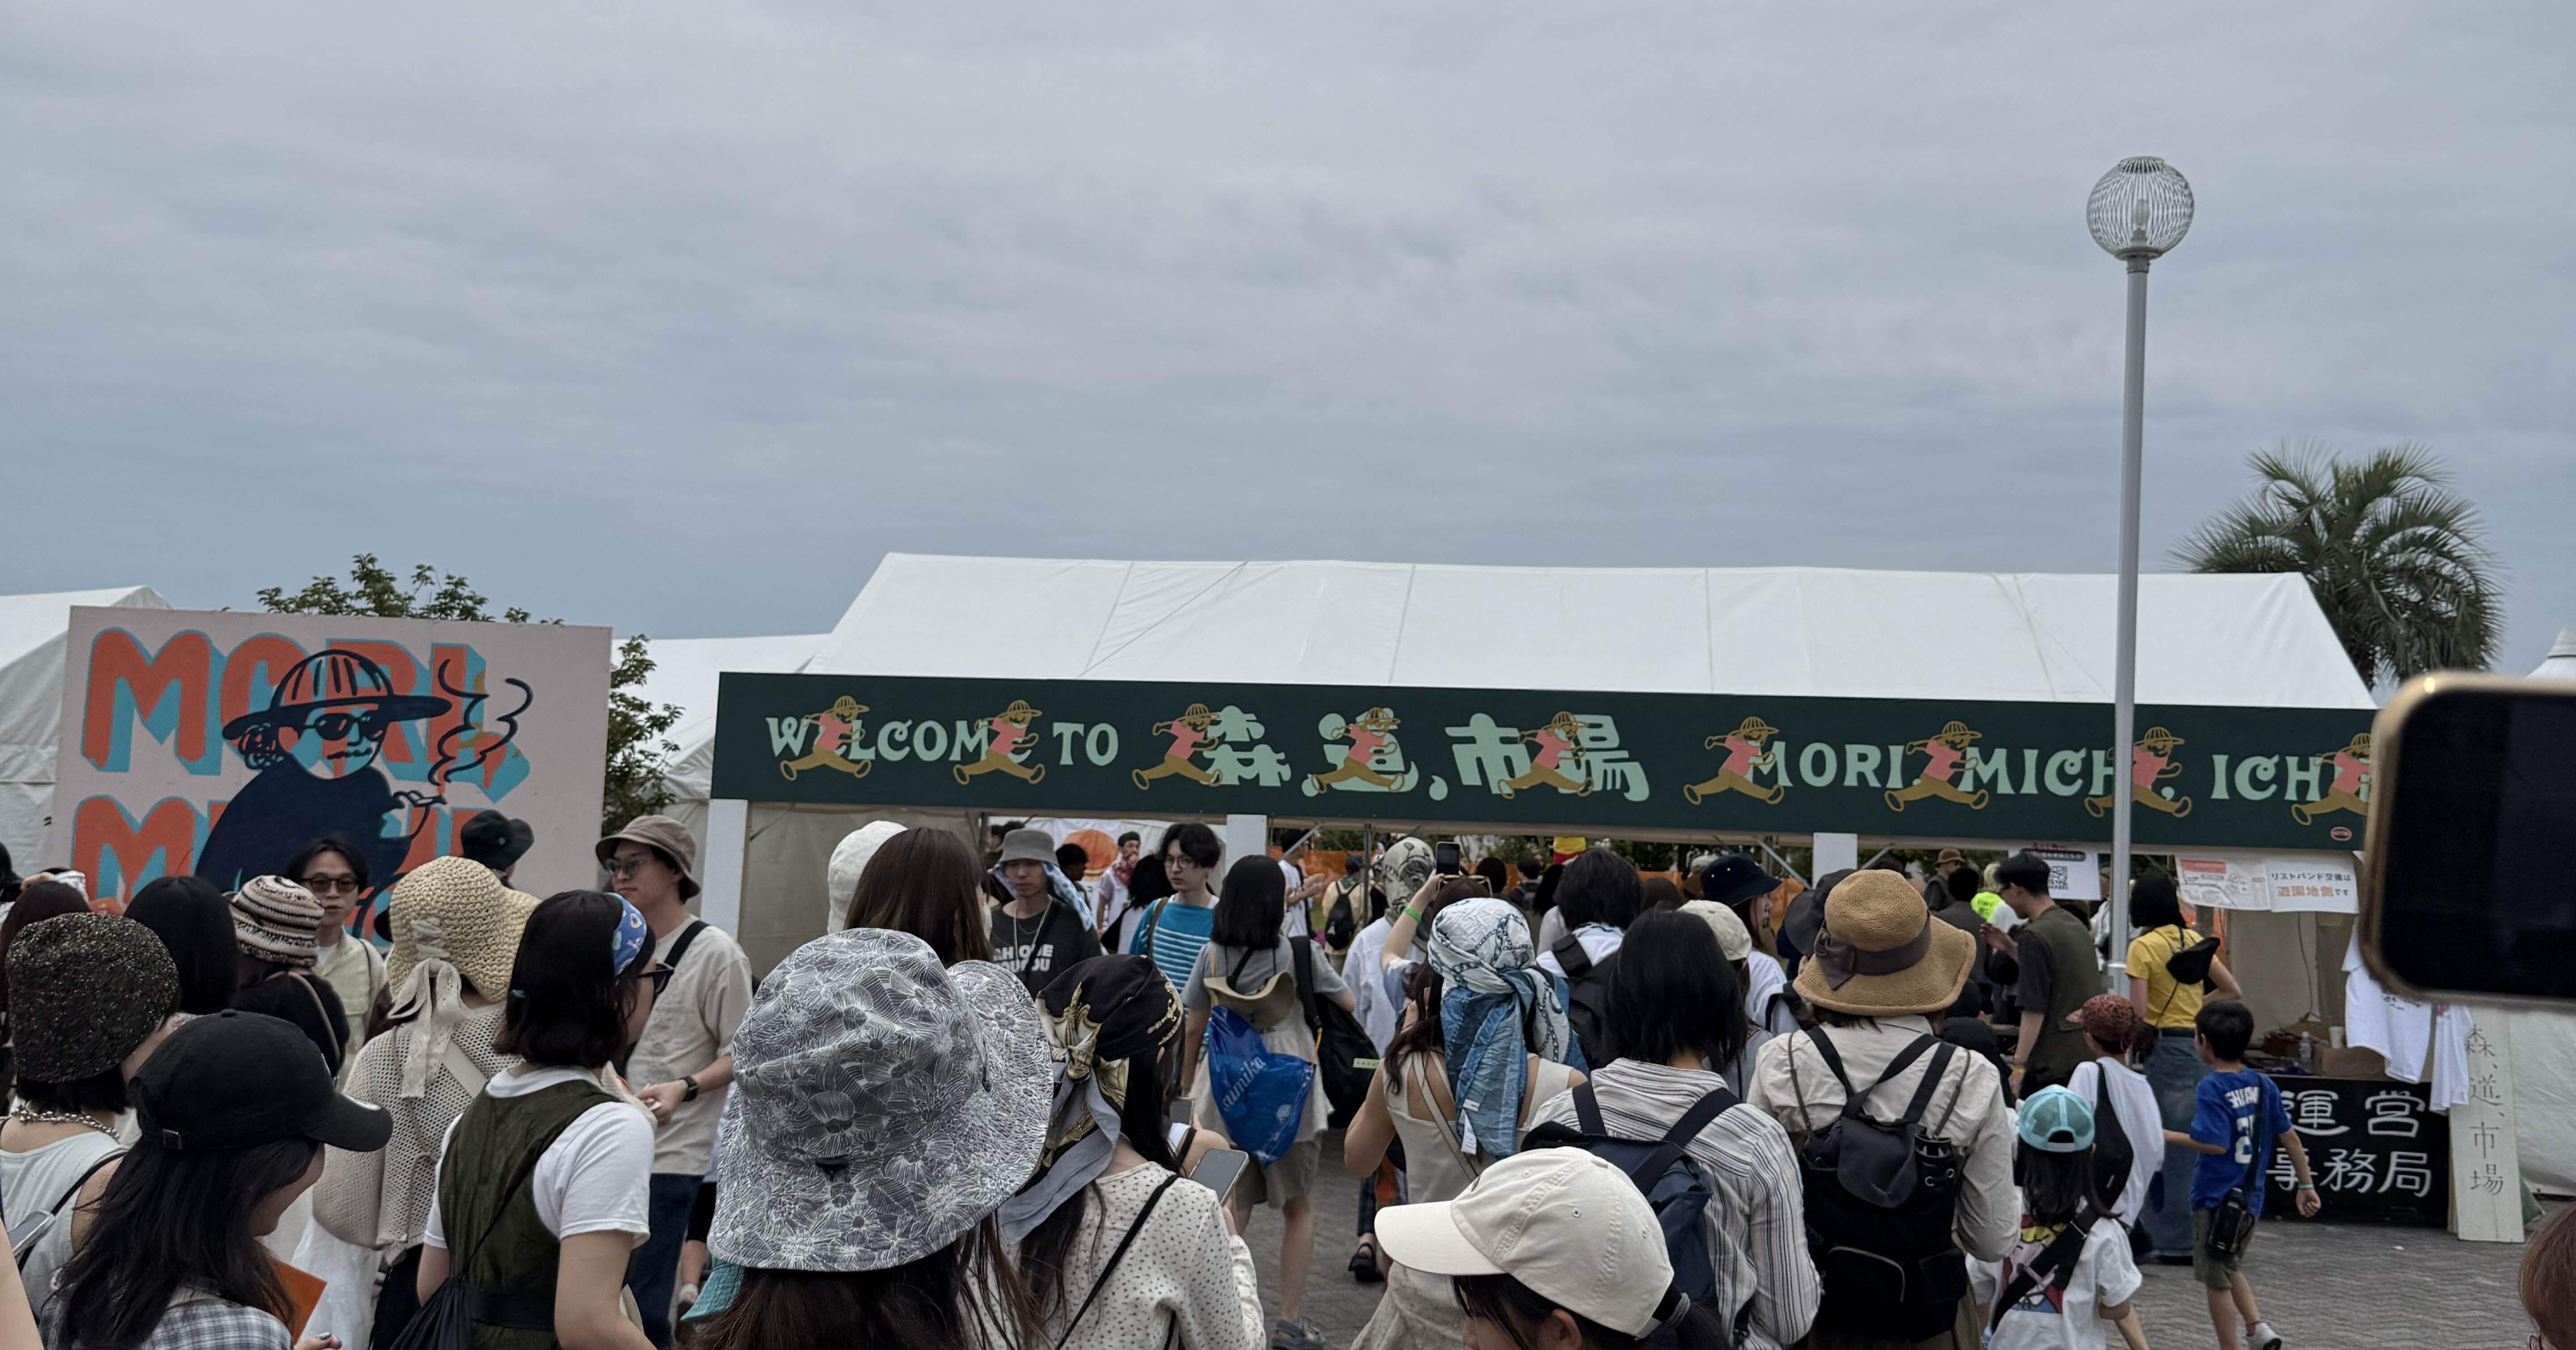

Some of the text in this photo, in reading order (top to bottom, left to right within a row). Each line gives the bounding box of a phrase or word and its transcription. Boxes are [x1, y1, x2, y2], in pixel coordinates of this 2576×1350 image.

[766, 717, 1119, 766] WLCOM TO
[1223, 1055, 1267, 1112] sumika
[2280, 1090, 2426, 1138] 運営
[2265, 1147, 2432, 1198] 事務局
